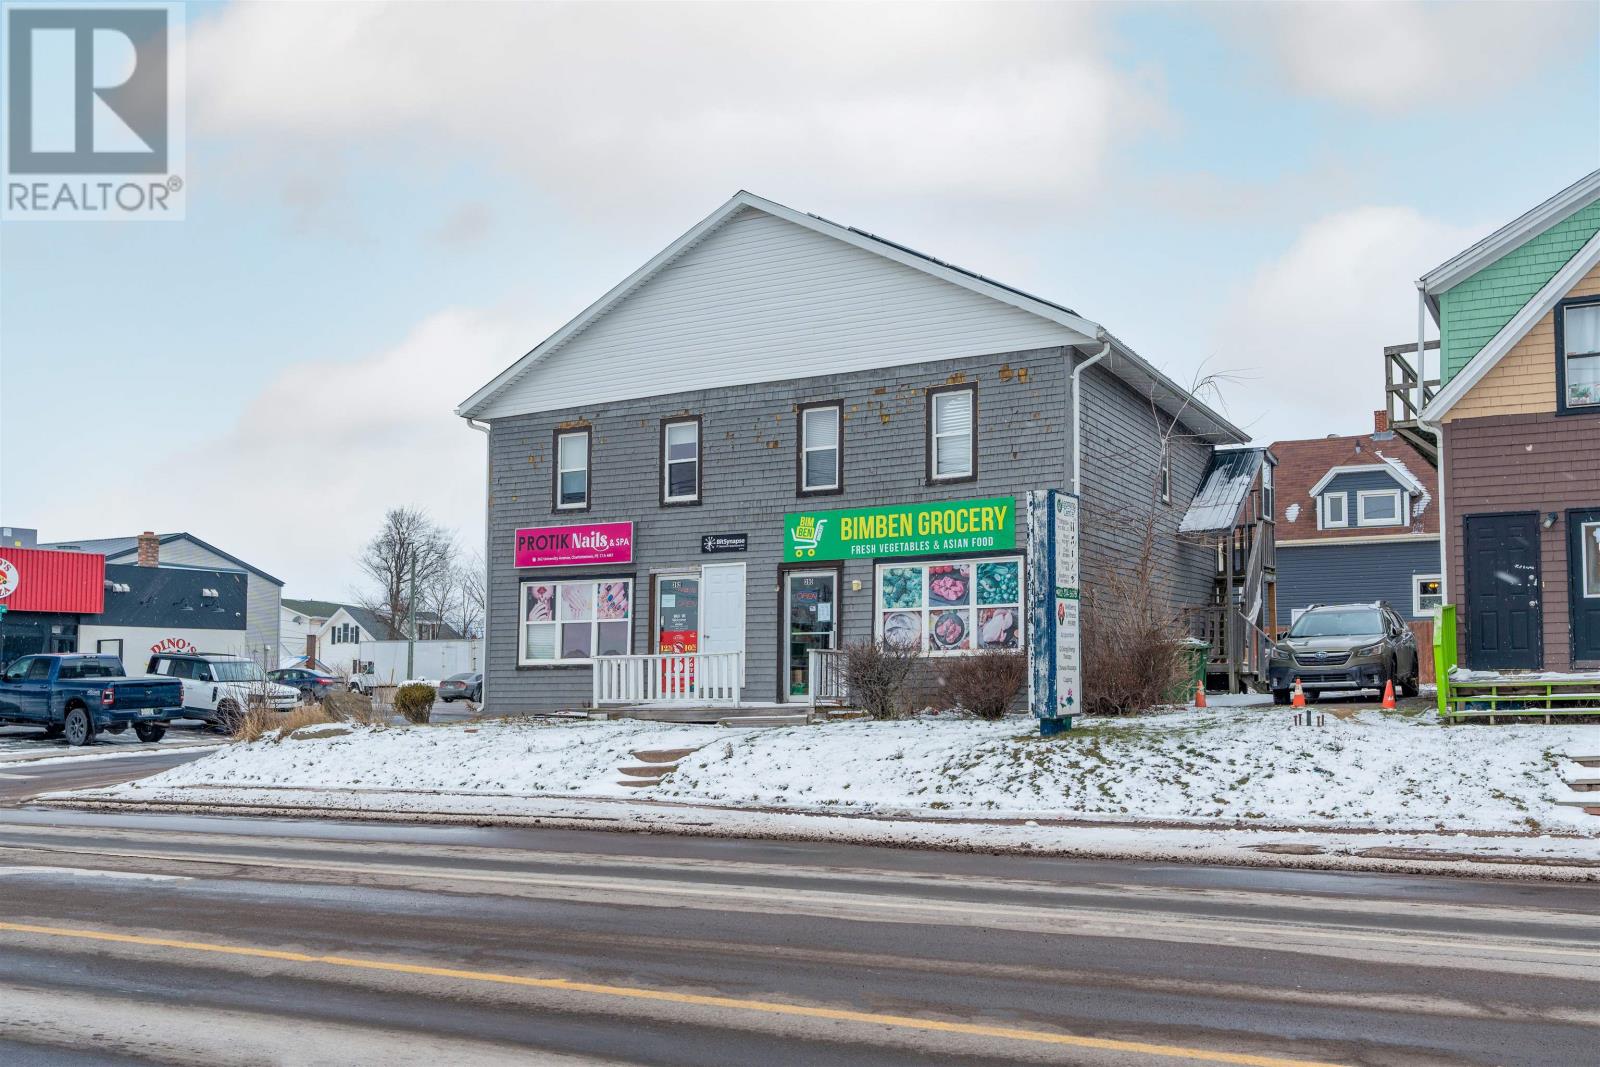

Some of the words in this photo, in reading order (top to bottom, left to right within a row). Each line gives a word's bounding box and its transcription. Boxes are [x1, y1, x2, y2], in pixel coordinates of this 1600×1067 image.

[800, 516, 815, 527] BIM
[841, 513, 913, 541] BIMBEN
[918, 506, 1008, 536] GROCERY
[518, 533, 570, 551] PROTIK
[571, 531, 609, 551] Nails
[609, 538, 615, 547] &
[615, 538, 630, 547] SPA
[798, 527, 813, 538] BEN
[851, 543, 876, 555] FRESH
[880, 540, 930, 553] VEGETABLES
[933, 540, 940, 550] &
[943, 538, 968, 549] ASIAN
[972, 536, 994, 547] FOOD
